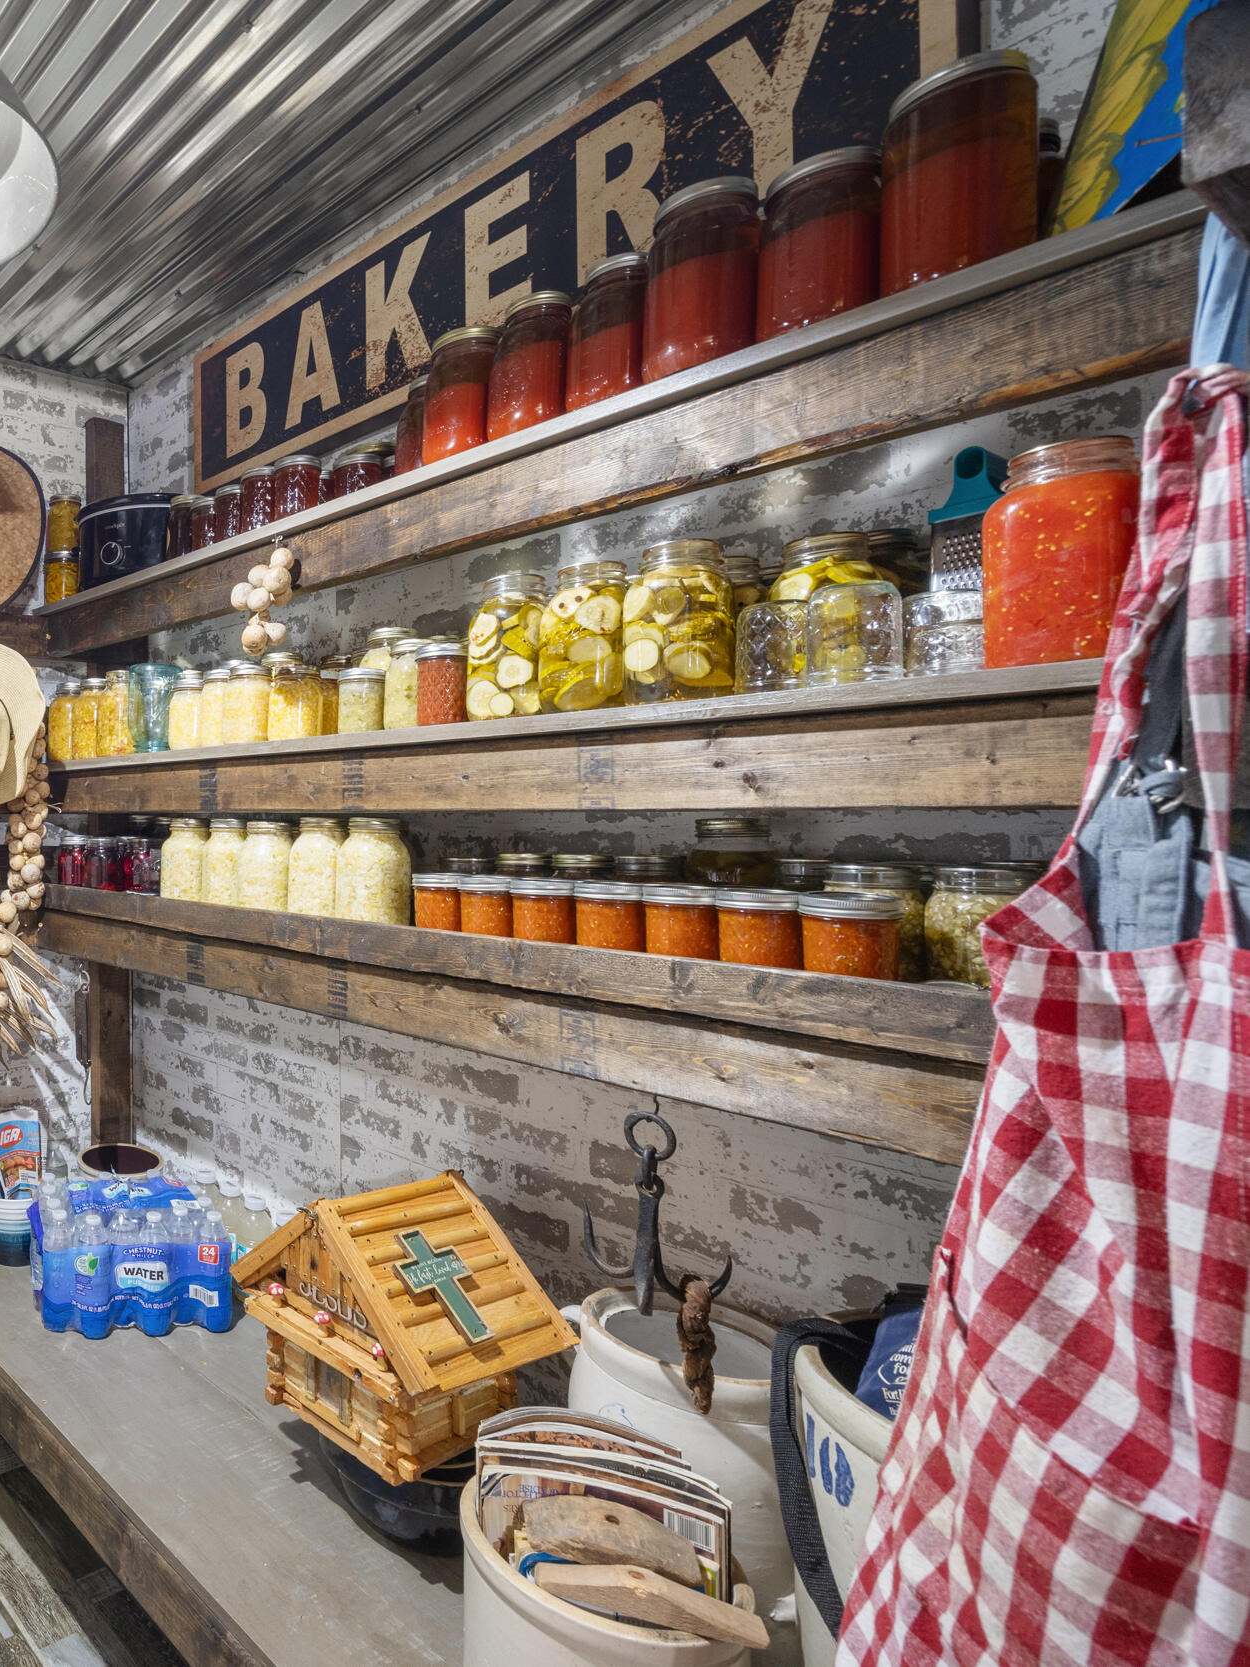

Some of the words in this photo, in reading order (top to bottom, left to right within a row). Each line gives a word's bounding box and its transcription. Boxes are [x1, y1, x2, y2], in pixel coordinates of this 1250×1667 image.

[225, 0, 835, 458] BAKERY
[123, 1247, 163, 1256] CHESTNUT
[202, 1247, 215, 1256] 24
[123, 1266, 164, 1281] WATER
